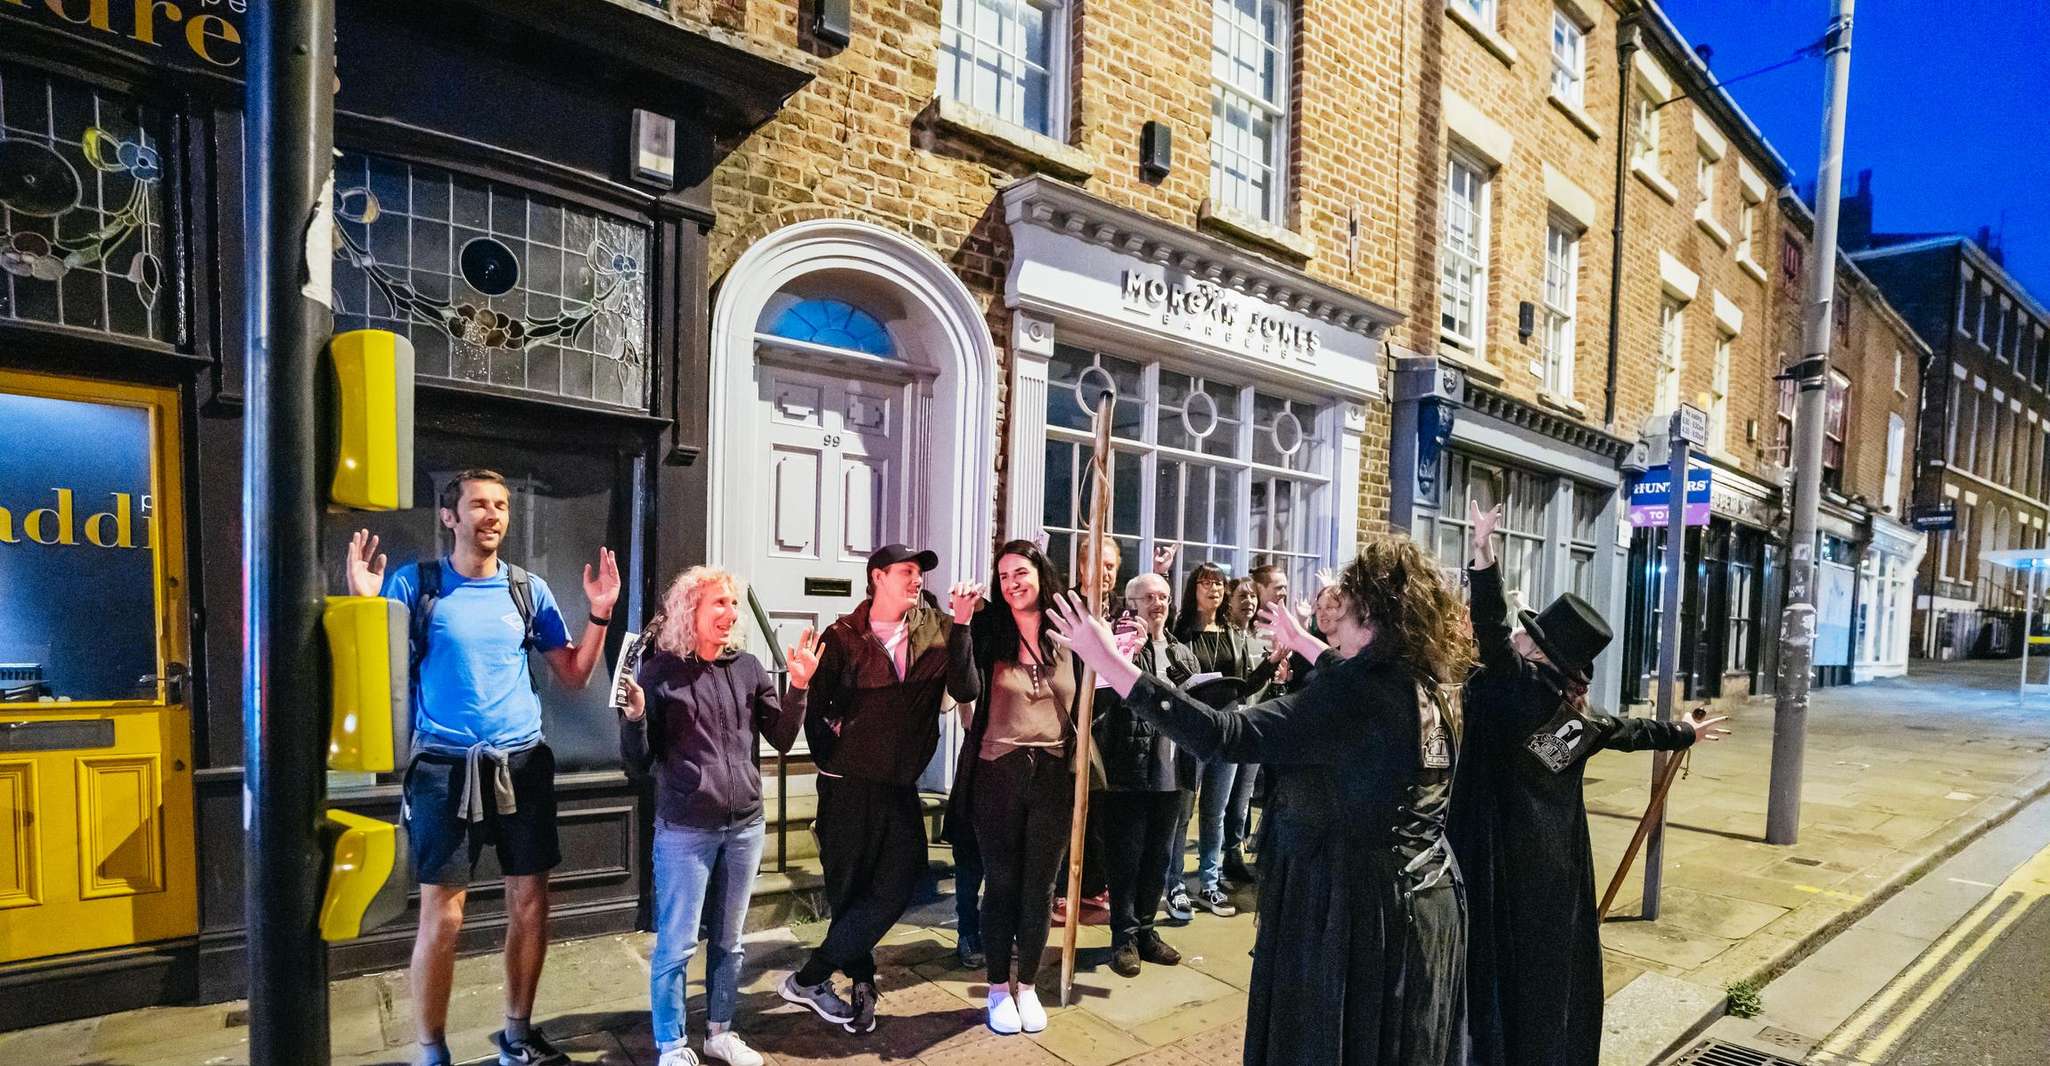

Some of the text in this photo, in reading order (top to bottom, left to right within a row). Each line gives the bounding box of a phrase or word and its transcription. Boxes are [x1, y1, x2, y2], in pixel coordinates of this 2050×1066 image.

[1122, 268, 1238, 326] MORGAN
[823, 434, 841, 448] 99
[1633, 480, 1706, 494] HUNTRS
[1649, 511, 1664, 520] TO
